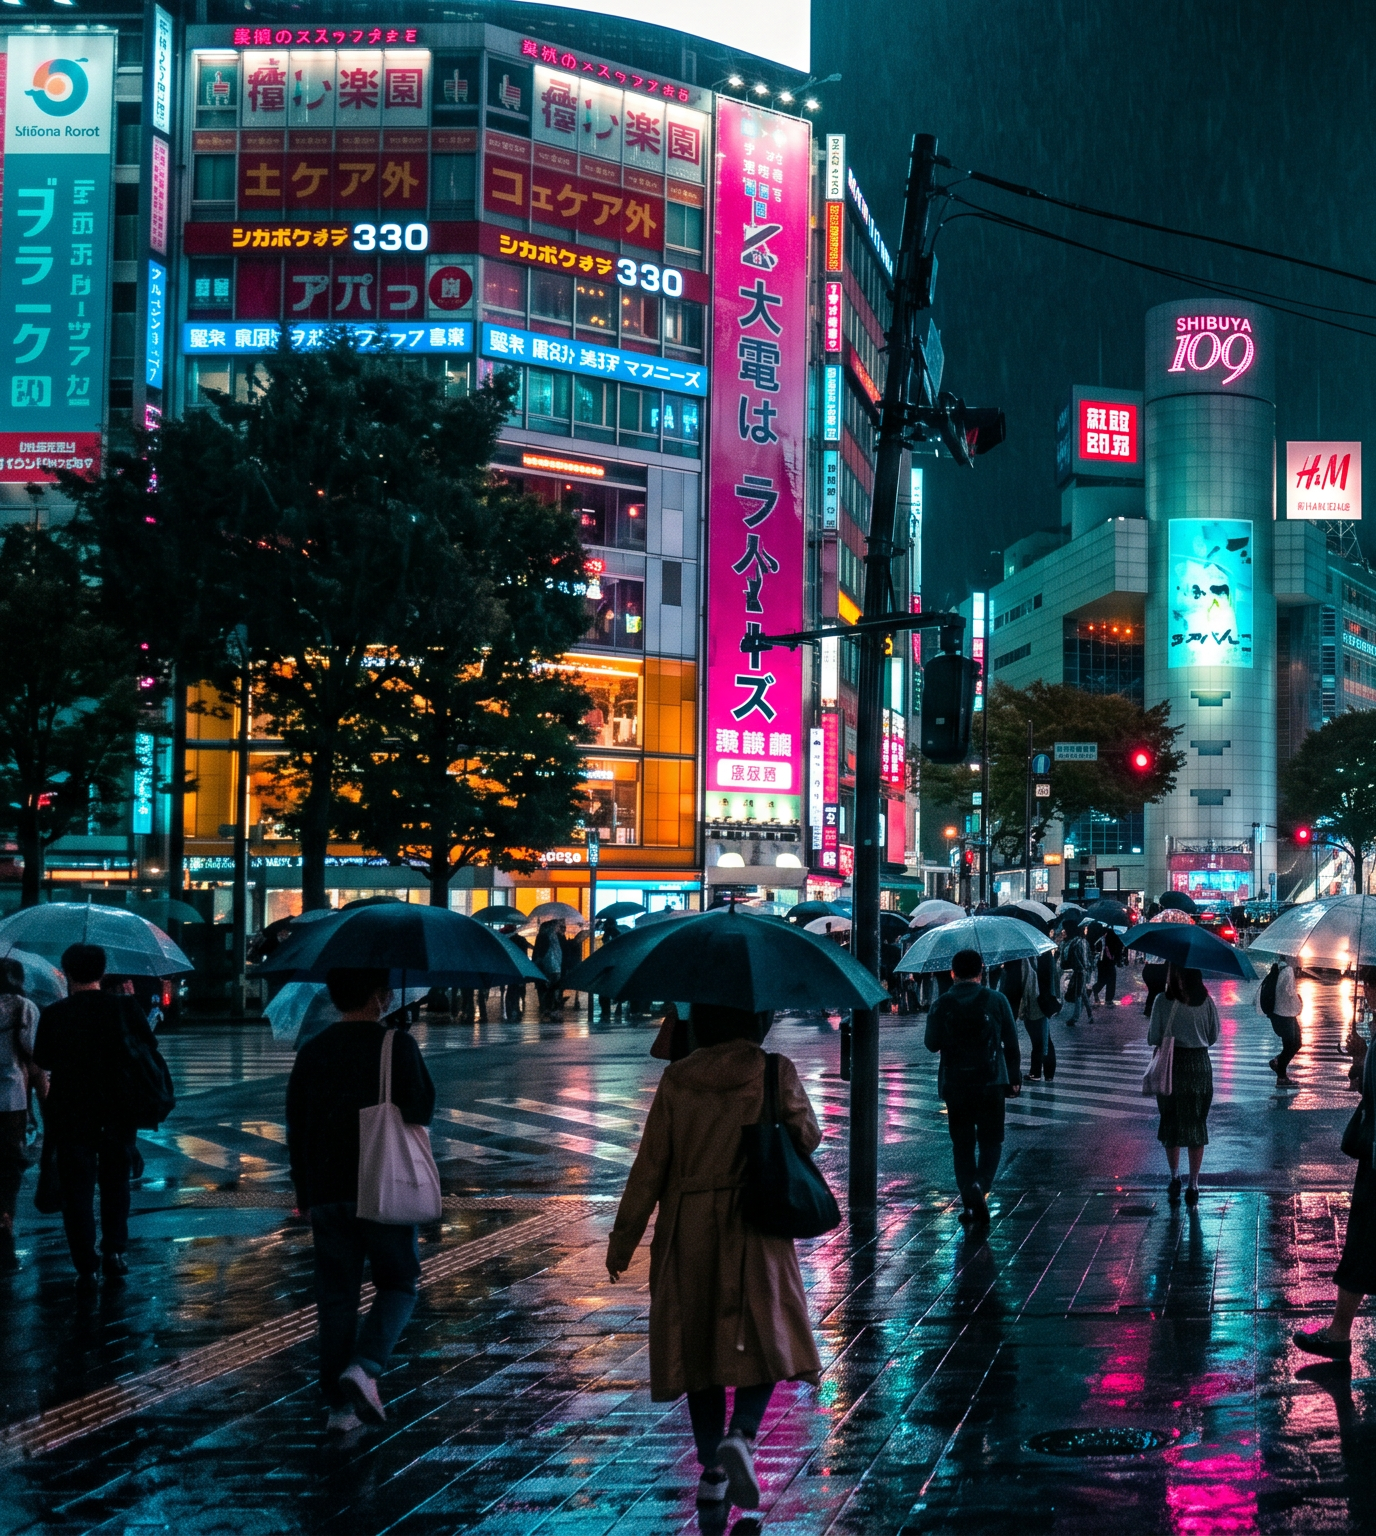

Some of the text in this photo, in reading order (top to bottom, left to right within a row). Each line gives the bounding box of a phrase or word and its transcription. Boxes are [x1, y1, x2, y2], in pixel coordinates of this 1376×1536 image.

[353, 223, 429, 251] 330
[616, 257, 684, 298] 330
[1176, 316, 1252, 333] SHIBUYA
[1167, 331, 1255, 385] 109
[1296, 453, 1351, 491] H&M
